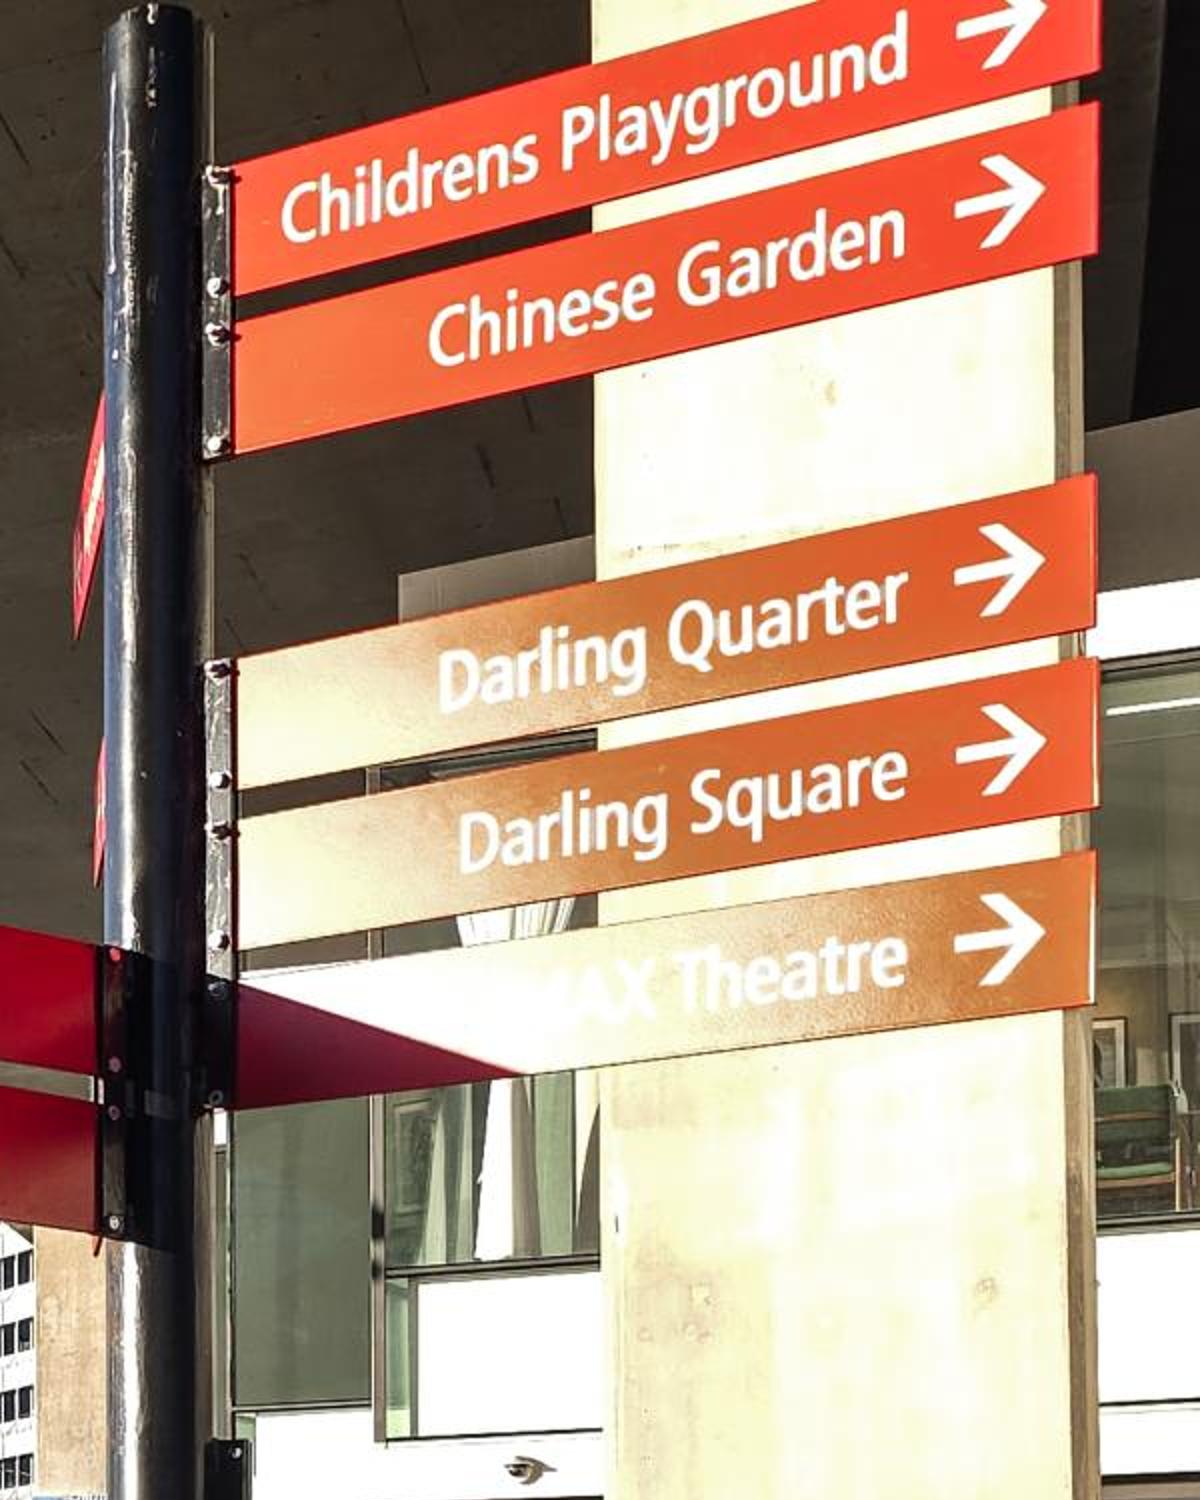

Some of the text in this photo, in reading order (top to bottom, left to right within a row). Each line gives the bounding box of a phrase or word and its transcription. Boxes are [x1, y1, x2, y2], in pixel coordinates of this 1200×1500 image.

[281, 10, 908, 243] Childrens Playground
[428, 208, 905, 367] Chinese Garden
[438, 572, 909, 715] Darling Quarter
[458, 751, 908, 876] Darling Square
[673, 935, 909, 1014] Theatre
